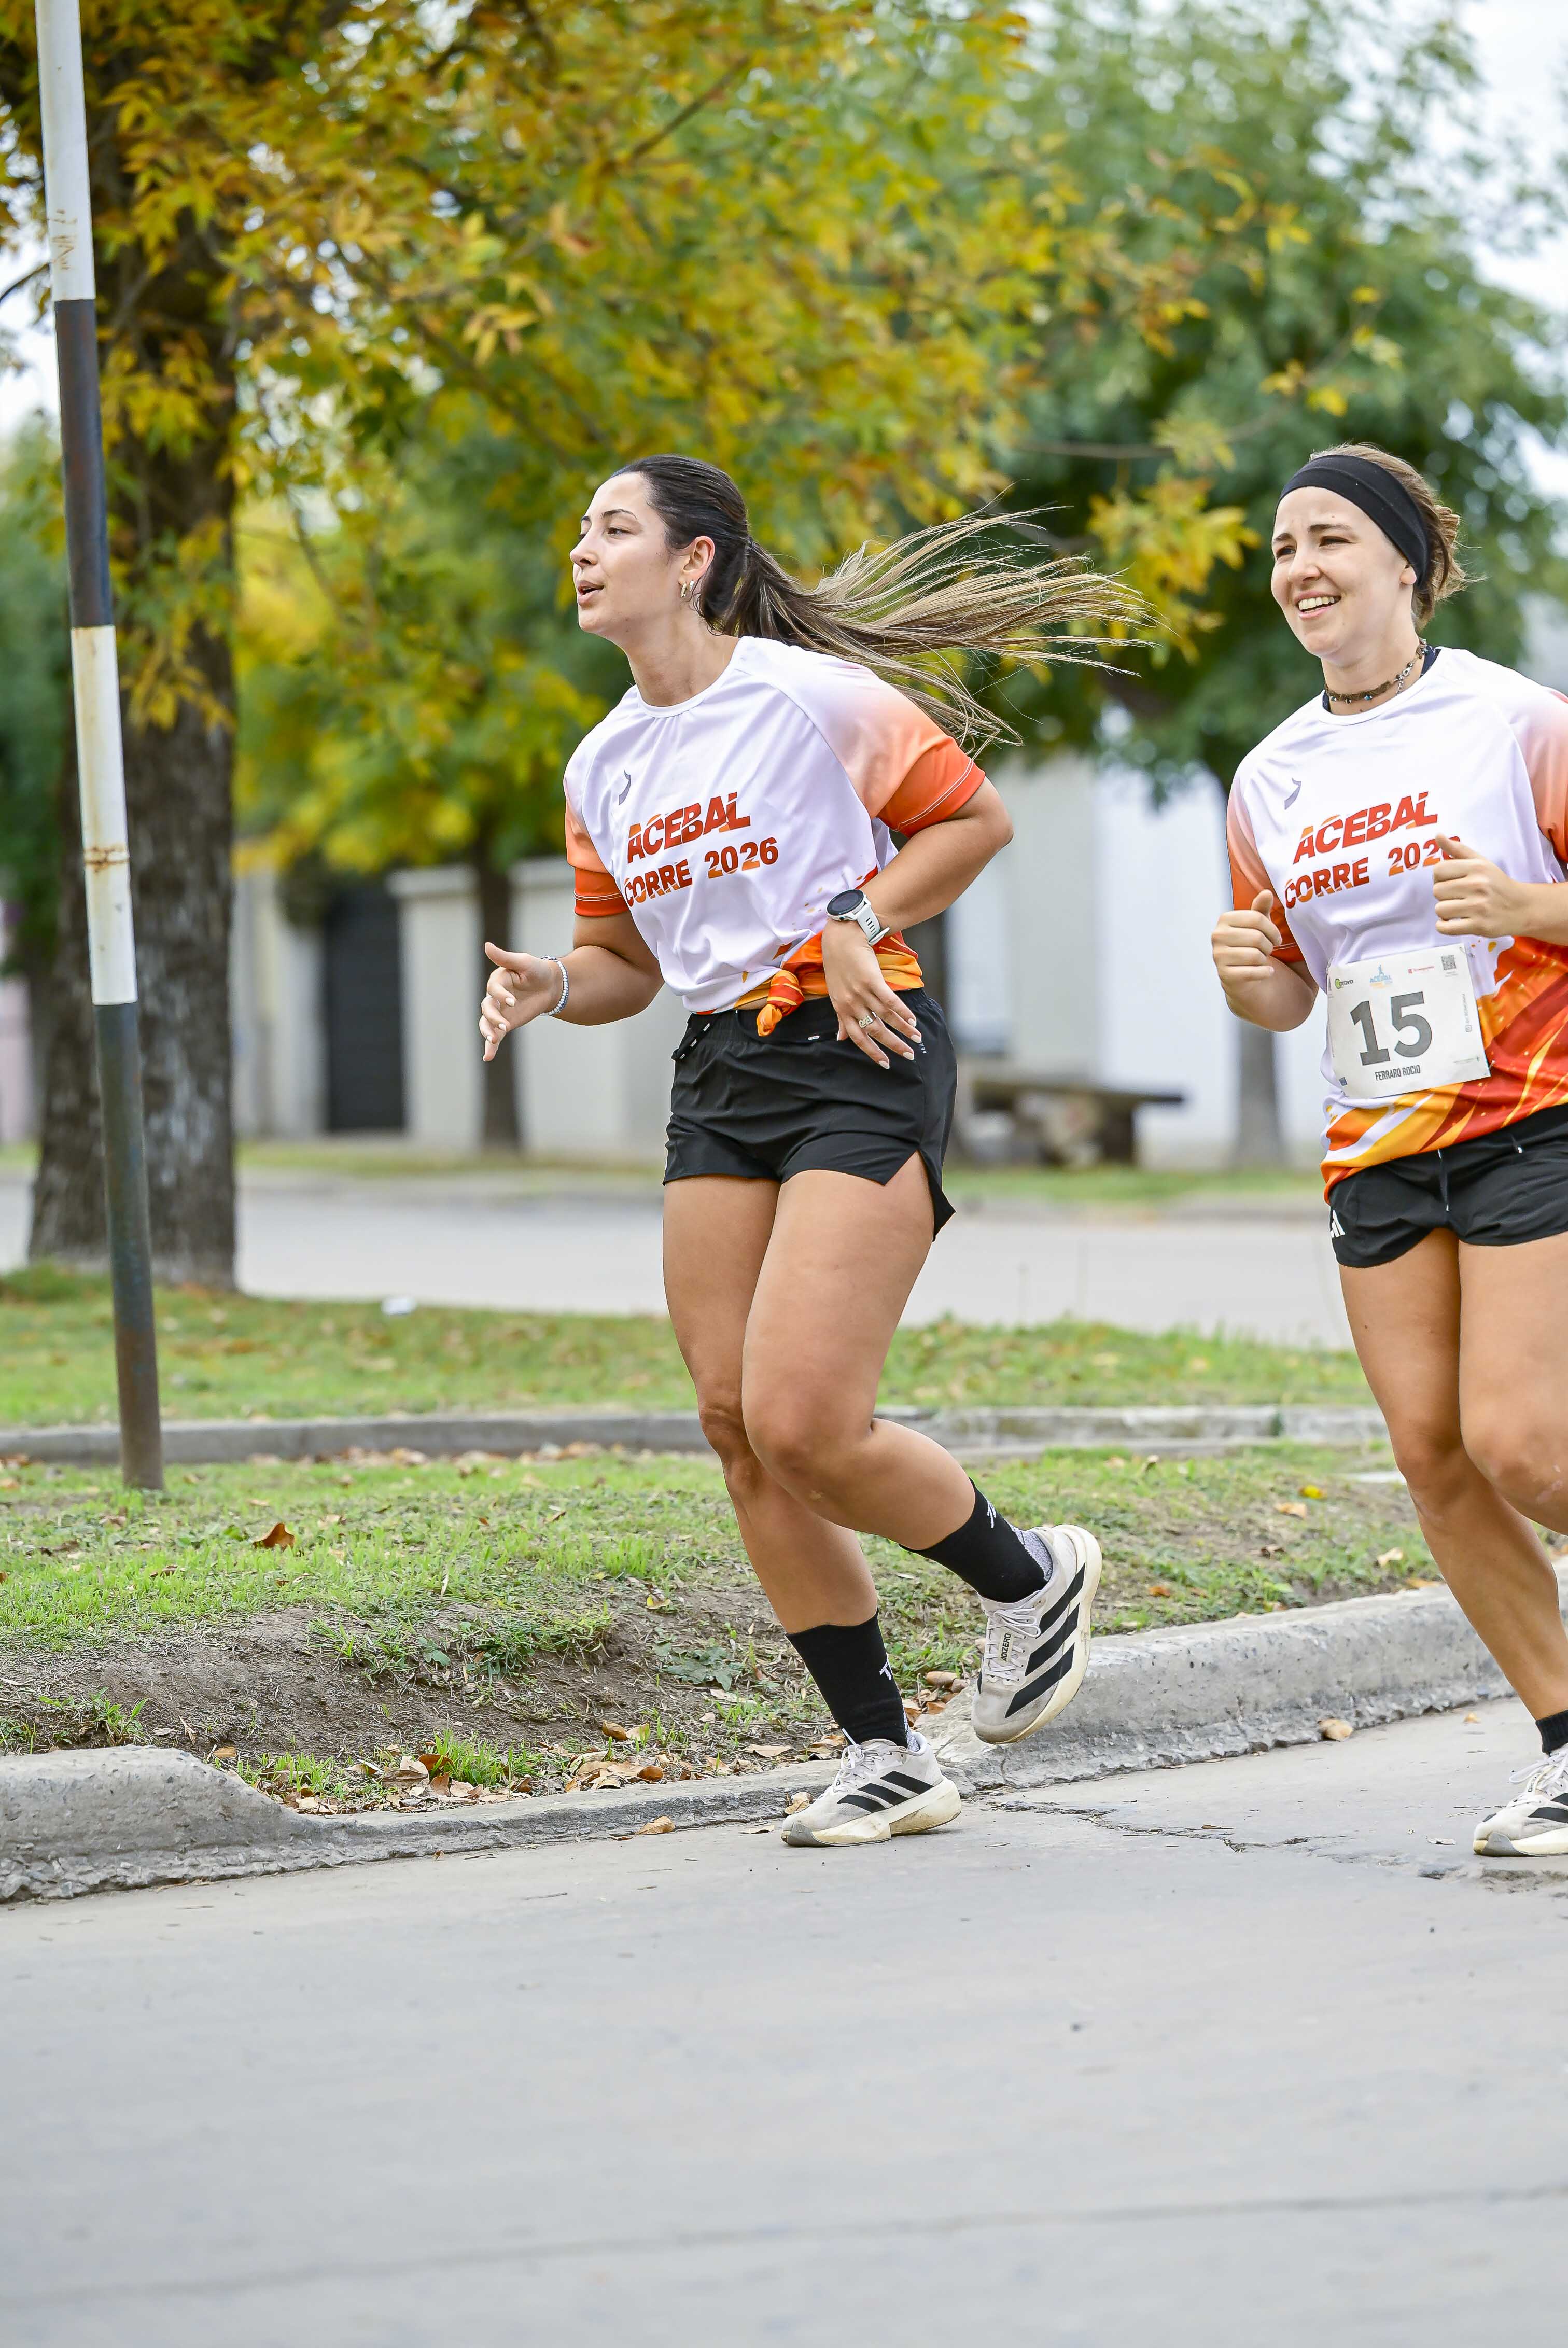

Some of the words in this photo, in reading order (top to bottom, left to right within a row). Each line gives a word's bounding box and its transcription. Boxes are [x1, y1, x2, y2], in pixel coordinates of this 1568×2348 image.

[627, 792, 750, 863] ACEBAL
[1293, 791, 1438, 864] ACEBAL
[624, 859, 692, 907] CORRE
[705, 837, 779, 879] 2026
[1284, 857, 1370, 909] CORRE
[1350, 991, 1432, 1066] 15
[1375, 1068, 1402, 1081] FERRARO
[1402, 1065, 1421, 1076] ROCIO
[1000, 1633, 1011, 1662] ADIZERO
